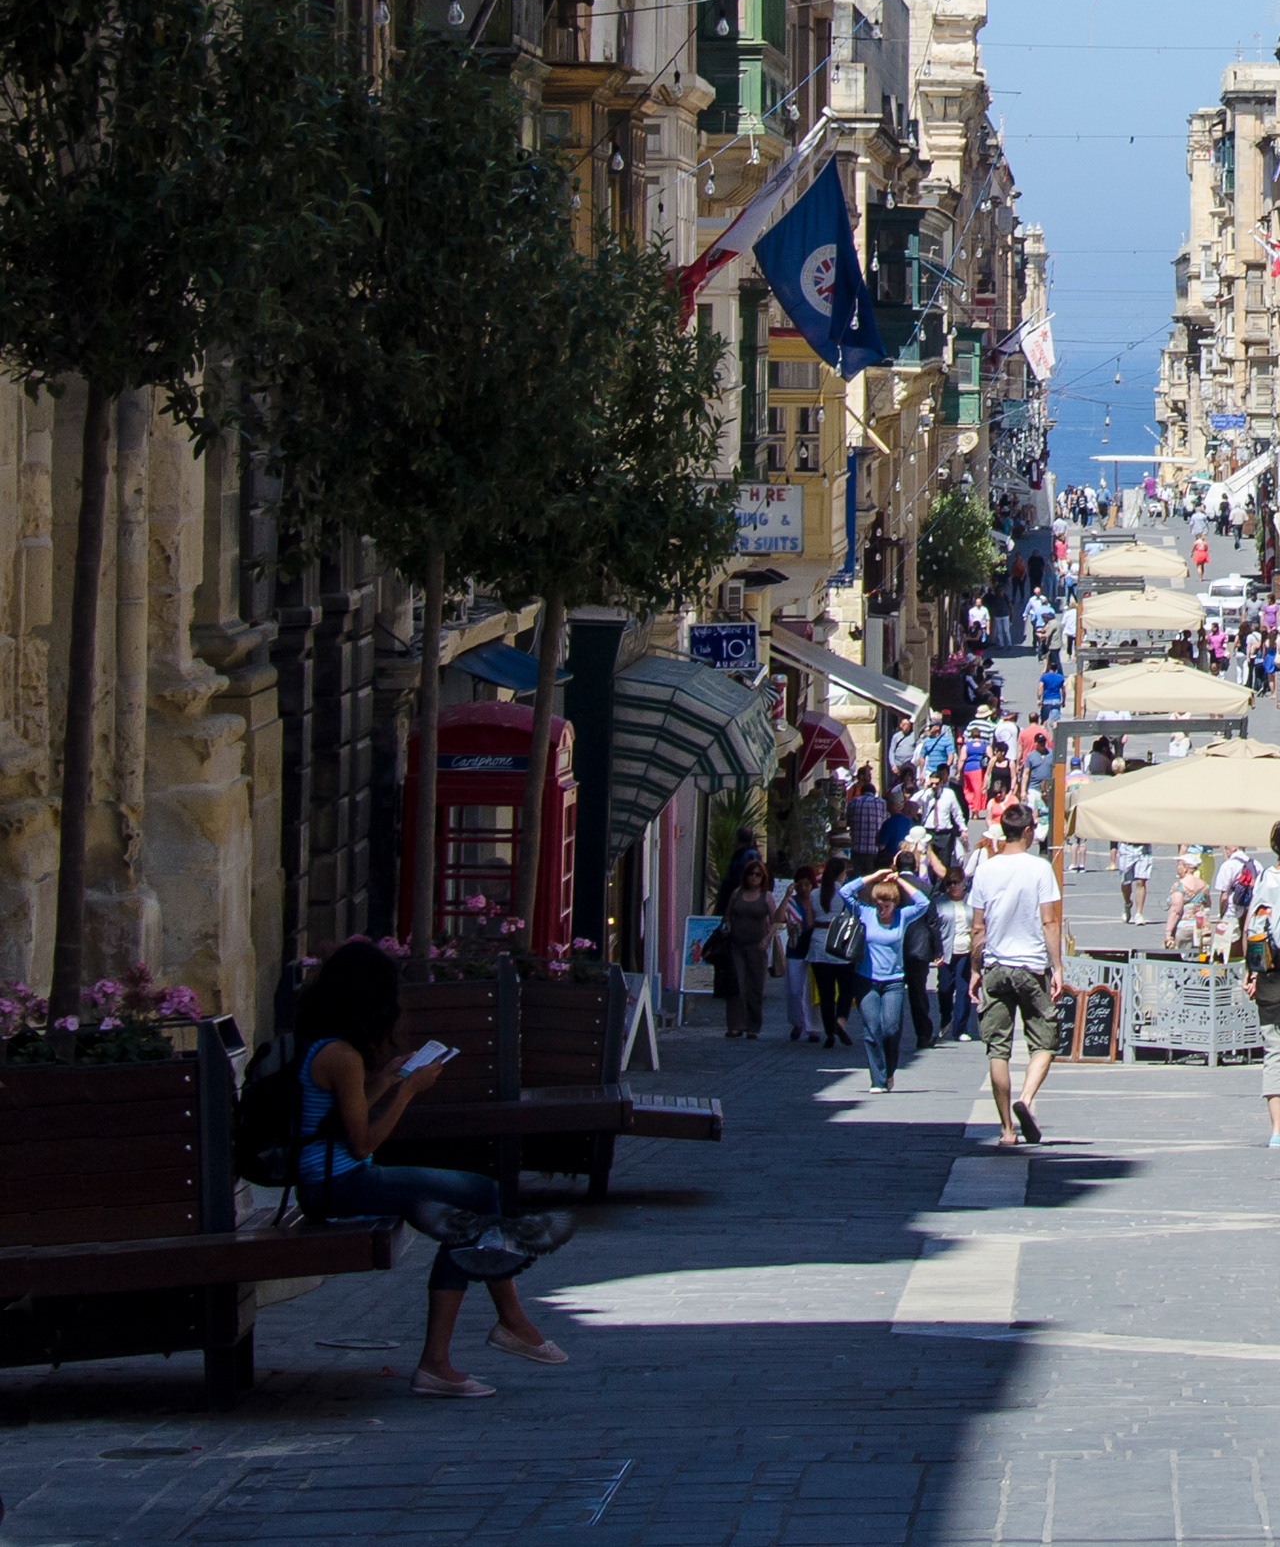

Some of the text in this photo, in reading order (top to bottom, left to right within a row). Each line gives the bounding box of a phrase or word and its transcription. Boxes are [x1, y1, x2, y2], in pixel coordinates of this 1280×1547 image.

[781, 514, 791, 526] &
[754, 536, 799, 551] SUITS
[451, 755, 514, 768] Cardphone
